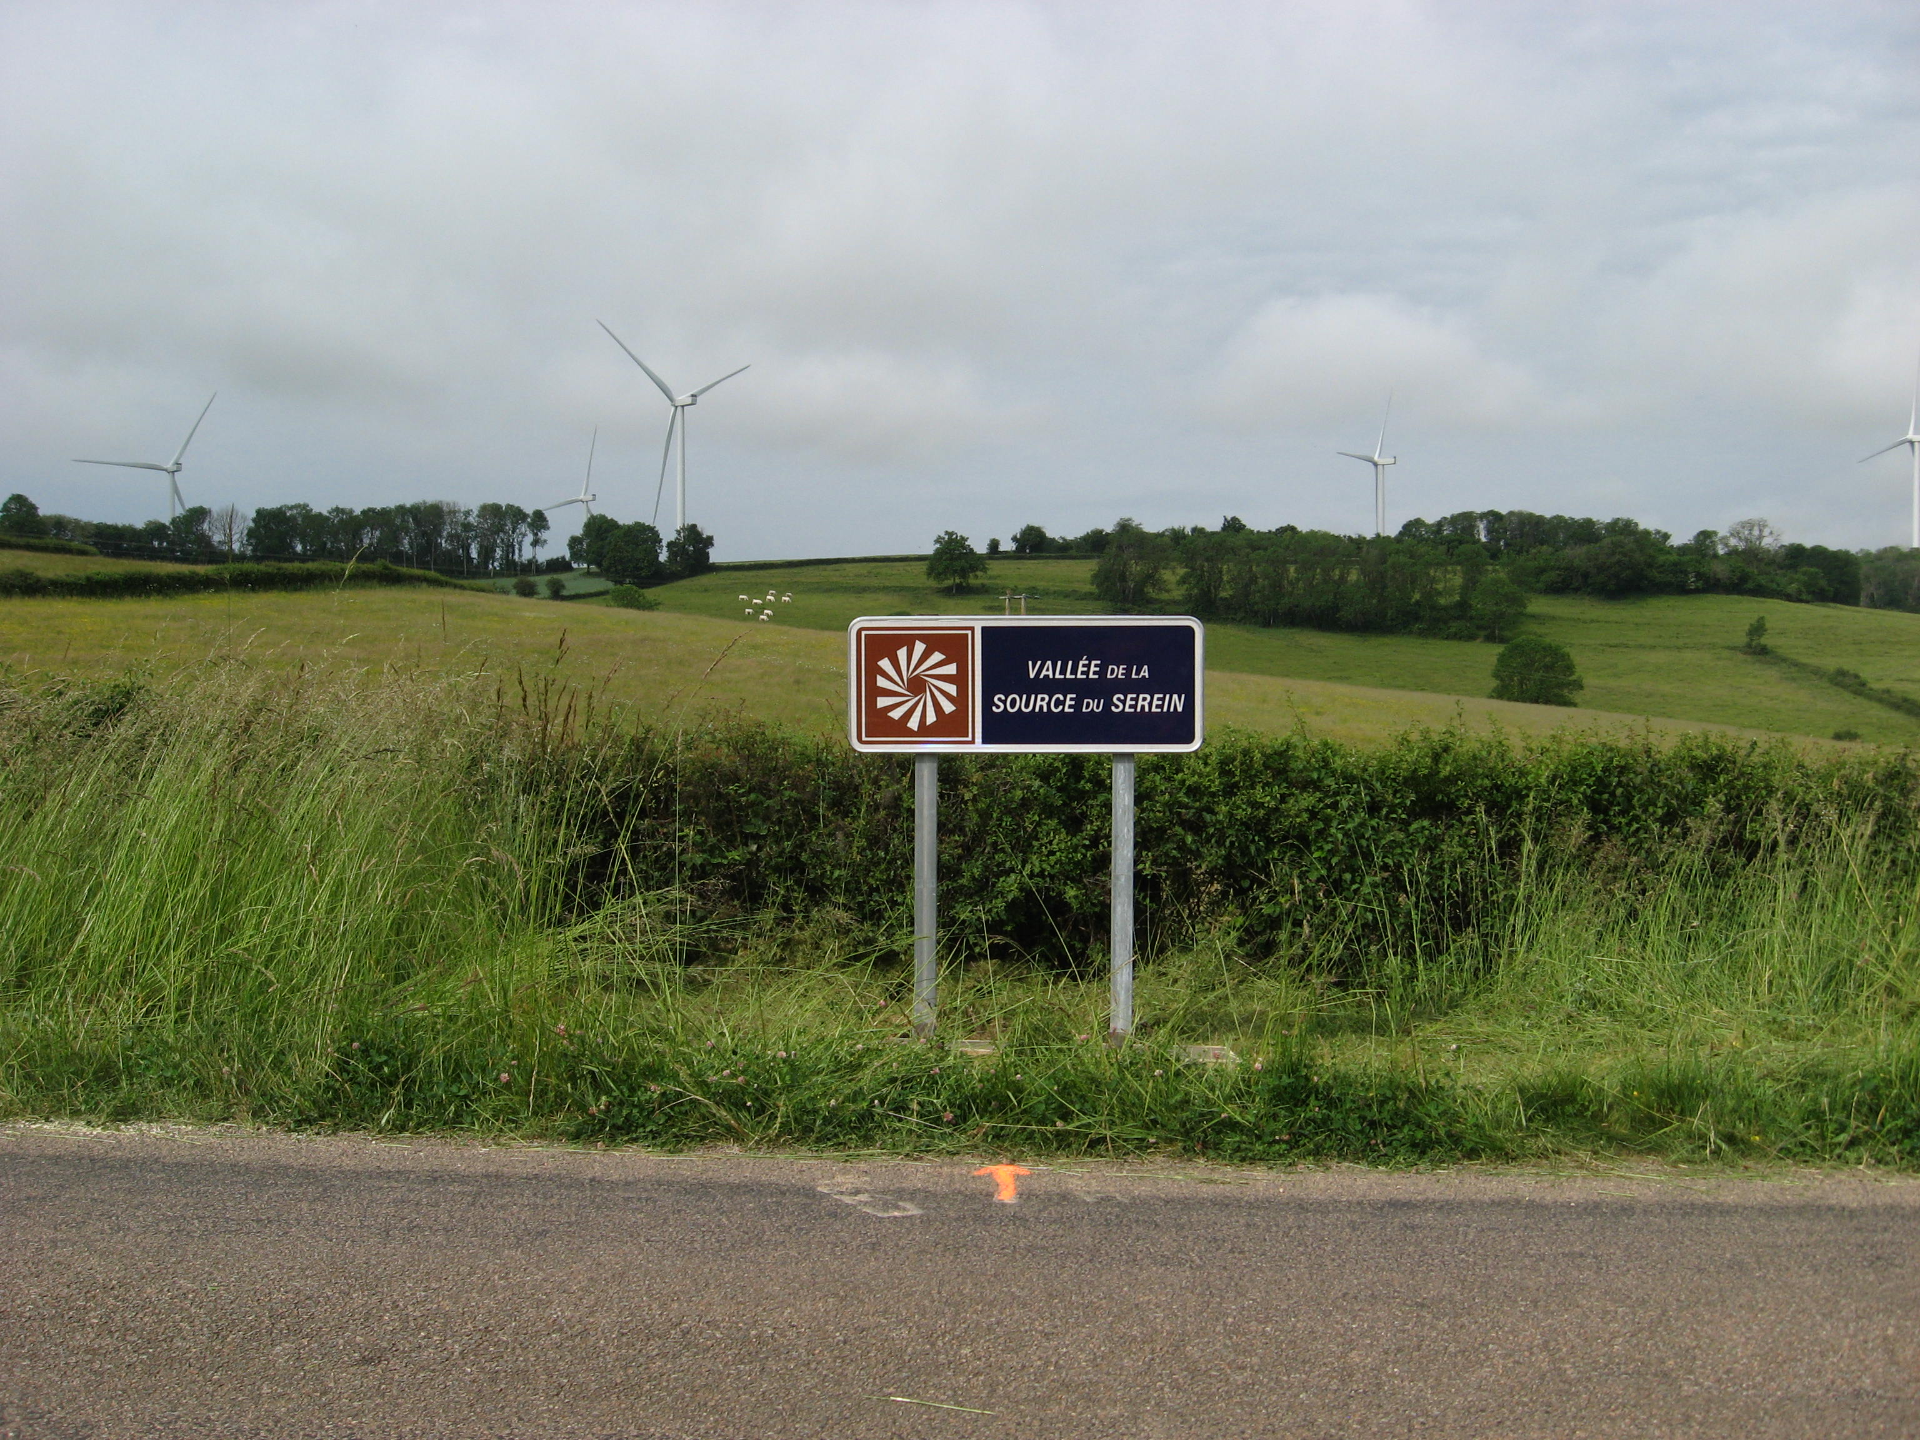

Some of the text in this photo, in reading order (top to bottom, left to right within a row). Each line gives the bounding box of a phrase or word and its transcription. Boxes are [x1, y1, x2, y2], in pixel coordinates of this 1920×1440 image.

[1028, 655, 1149, 679] VALLÉE DE LA
[991, 693, 1186, 713] SOURCE DU SEREIN
